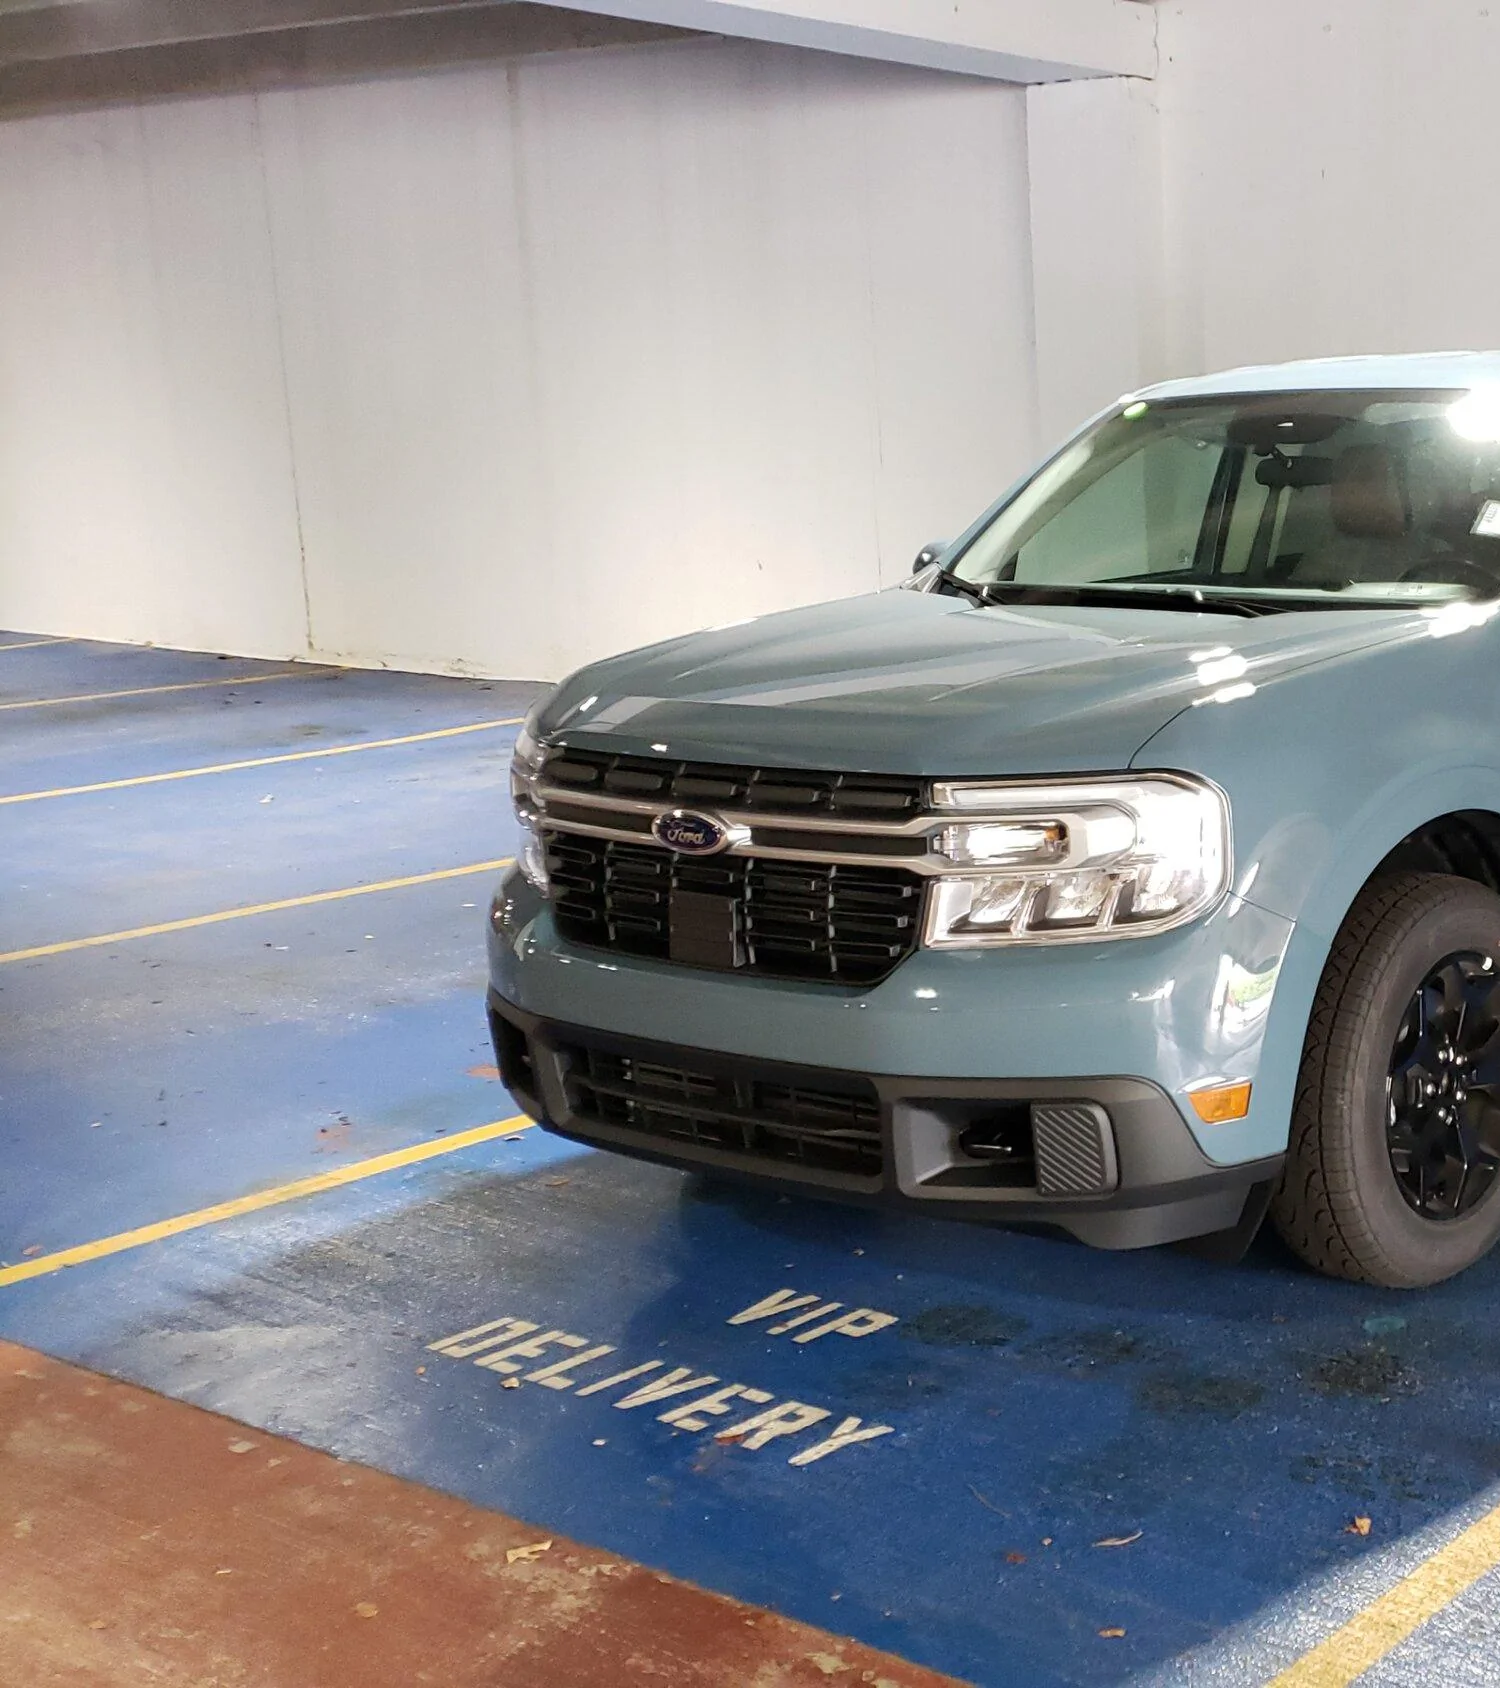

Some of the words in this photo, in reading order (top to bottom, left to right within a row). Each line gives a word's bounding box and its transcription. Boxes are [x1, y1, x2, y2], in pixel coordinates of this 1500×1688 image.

[667, 820, 706, 845] Ford
[725, 1288, 900, 1343] VIP
[424, 1316, 896, 1467] DELIVERY
